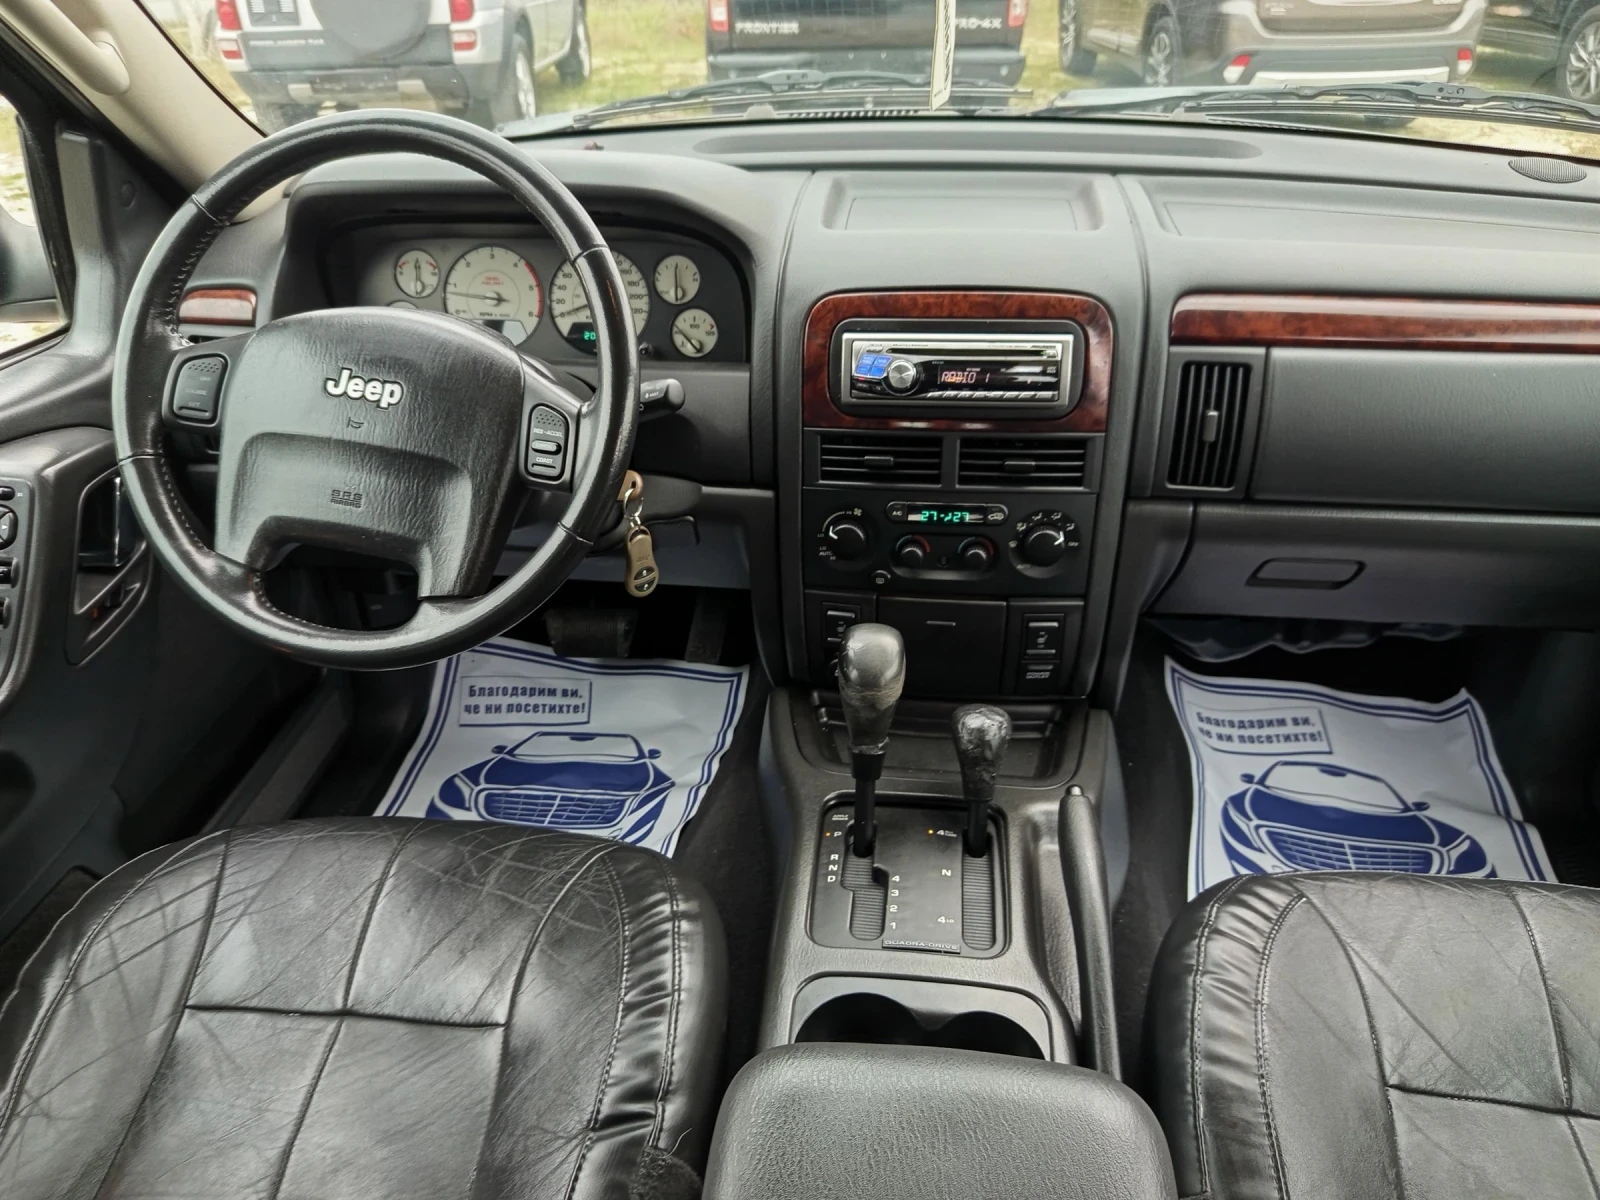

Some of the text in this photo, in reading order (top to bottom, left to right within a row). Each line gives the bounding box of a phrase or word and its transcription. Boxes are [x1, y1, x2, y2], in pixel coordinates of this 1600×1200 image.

[941, 371, 977, 384] RADIO
[325, 367, 404, 409] Jeep
[921, 510, 970, 522] 27 27
[469, 685, 557, 698] Благодарим
[464, 702, 586, 714] че ни посетихте!
[1196, 711, 1288, 729] Благодарим
[1216, 731, 1234, 743] ни
[1238, 730, 1323, 744] посетихте!
[941, 869, 952, 877] N
[890, 889, 899, 897] 3
[889, 904, 898, 912] 2
[889, 922, 896, 930] 1
[937, 916, 946, 924] 4
[884, 940, 959, 950] QUADRA-DRIVE
